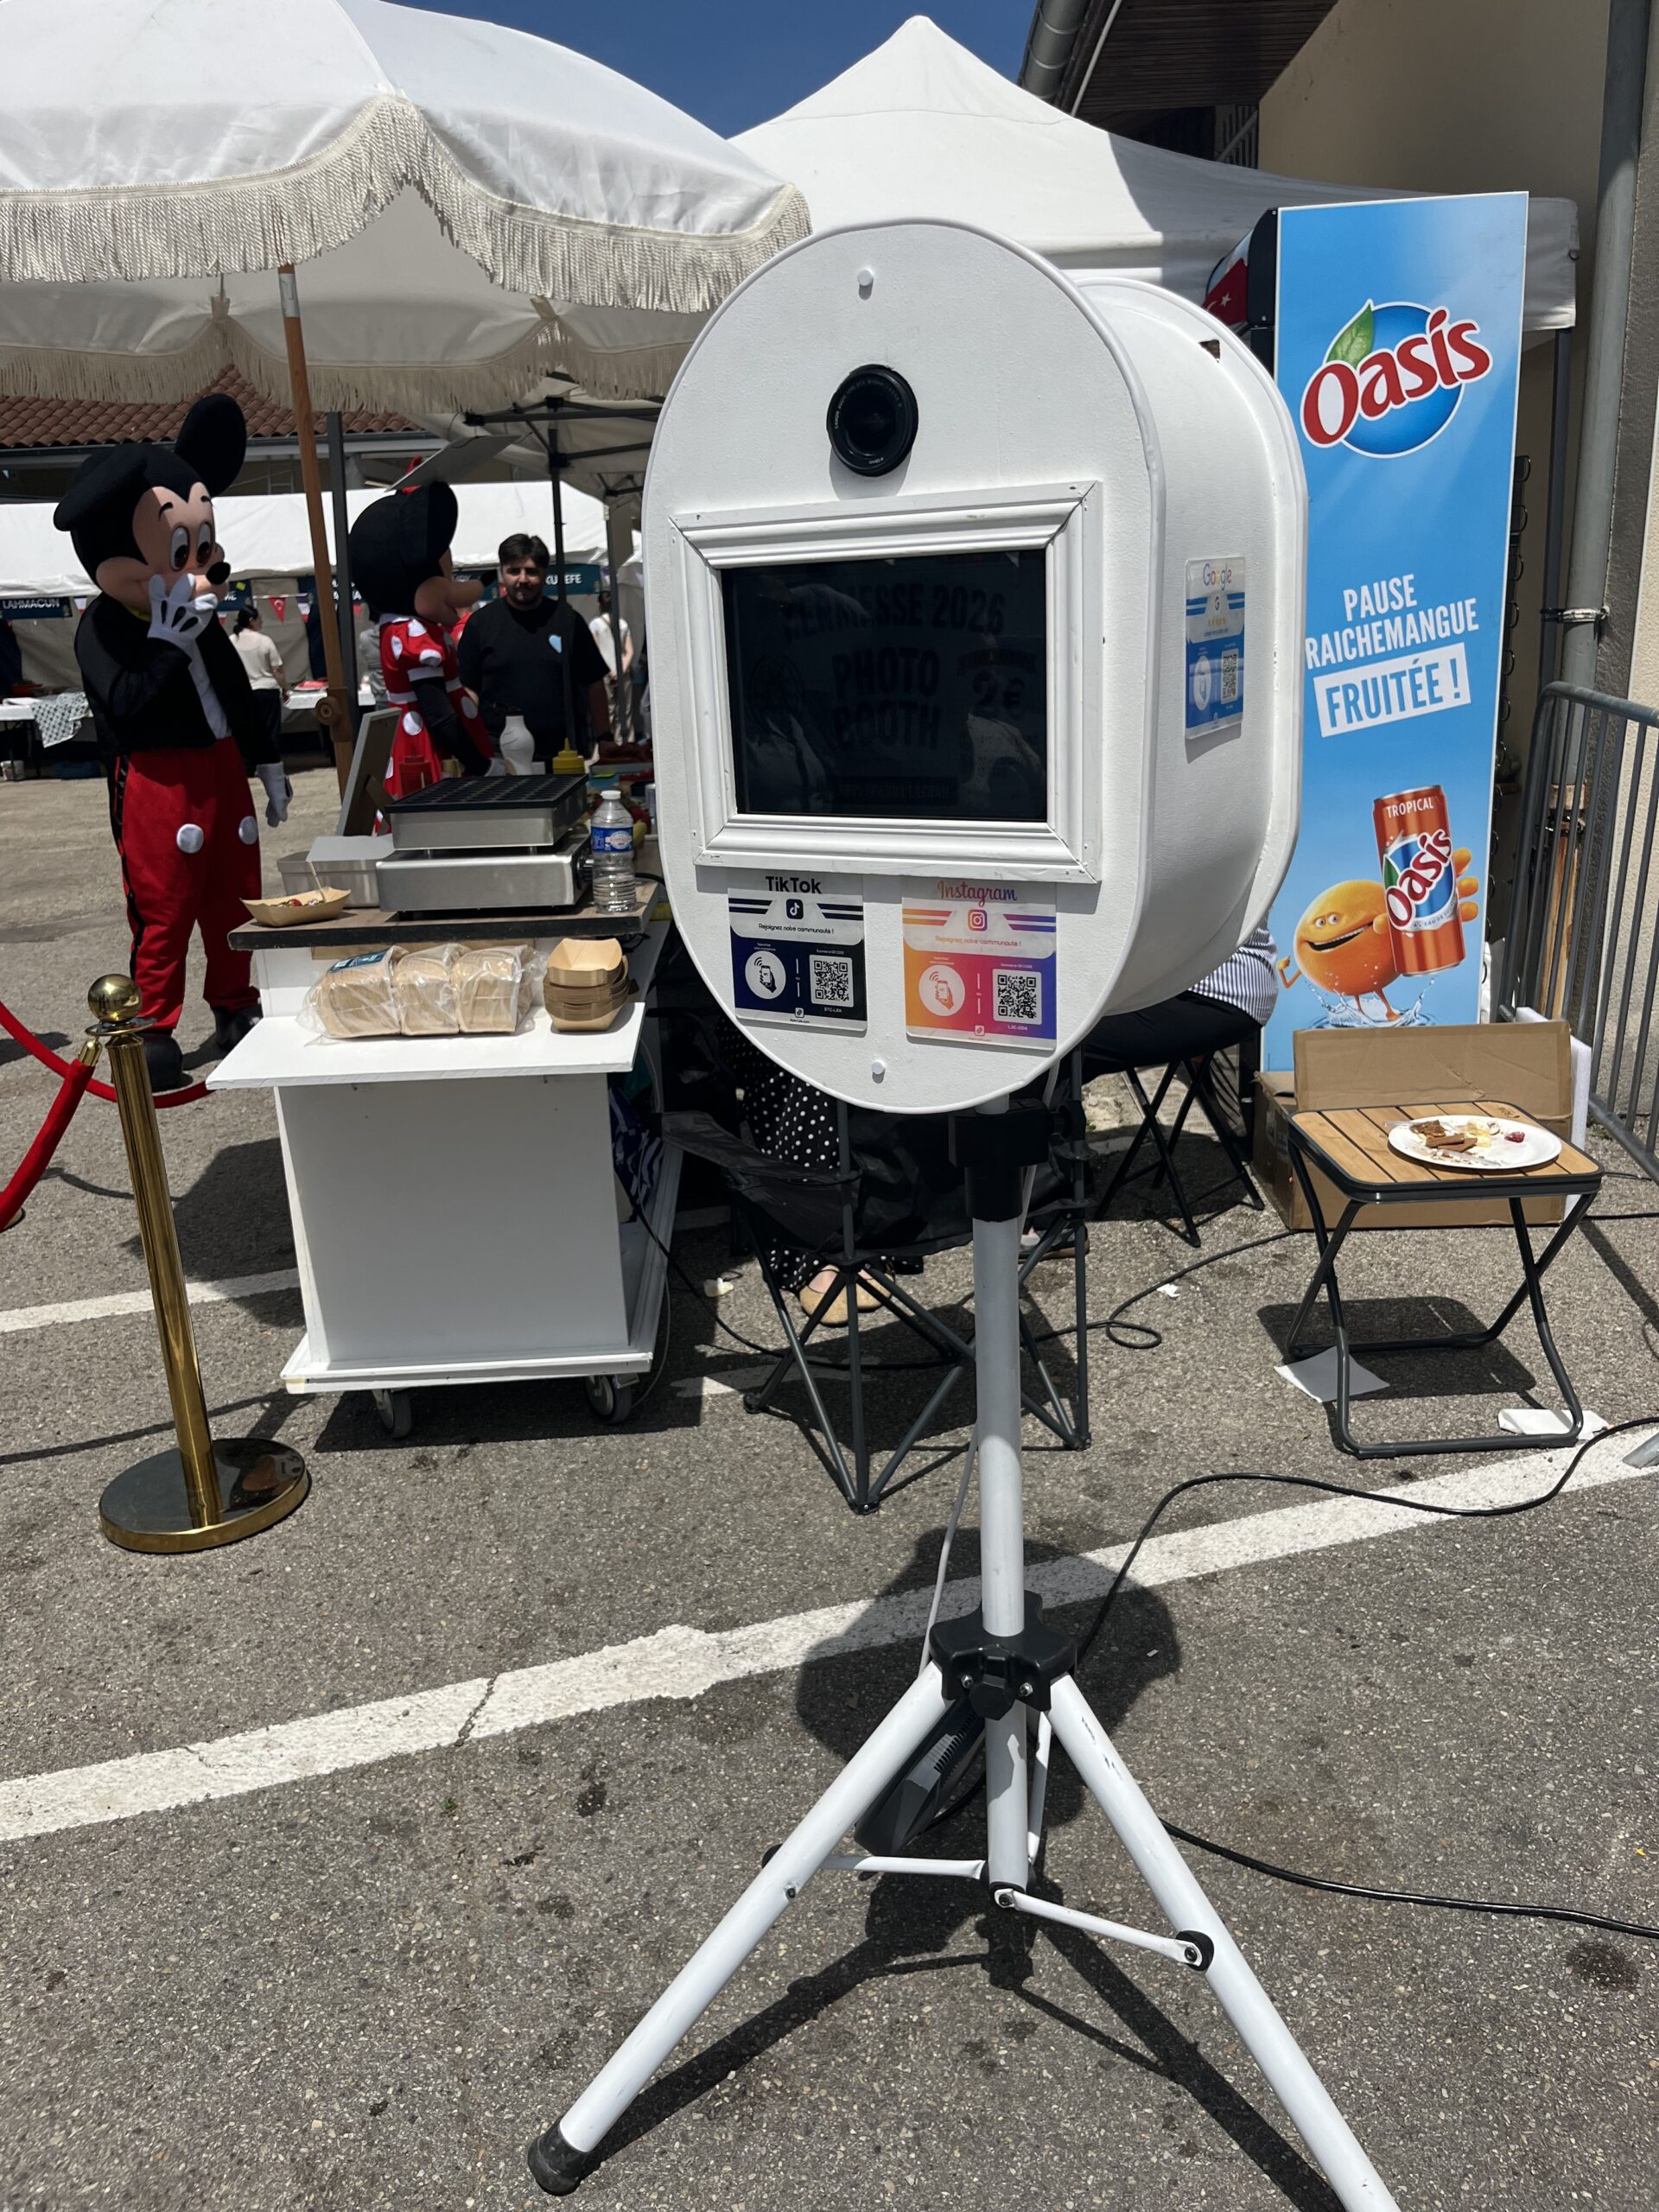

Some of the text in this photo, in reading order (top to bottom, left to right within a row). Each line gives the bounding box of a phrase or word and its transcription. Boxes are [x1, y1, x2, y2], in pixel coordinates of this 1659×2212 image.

[1301, 308, 1492, 447] Oasis
[545, 574, 582, 585] KUEFE
[1203, 563, 1232, 591] Google
[1343, 574, 1417, 622] PAUSE
[931, 583, 1007, 636] 2026
[1305, 598, 1479, 670] RAICHEMANGUE
[831, 646, 941, 698] PHOTO
[1325, 658, 1461, 728] FRUITÉE !
[832, 701, 942, 751] BOOTH
[1387, 798, 1434, 818] TROPICAL
[765, 875, 823, 894] TikTok
[937, 880, 1018, 907] Instagram
[1386, 830, 1452, 926] Oasis
[758, 923, 783, 931] Rejoignez
